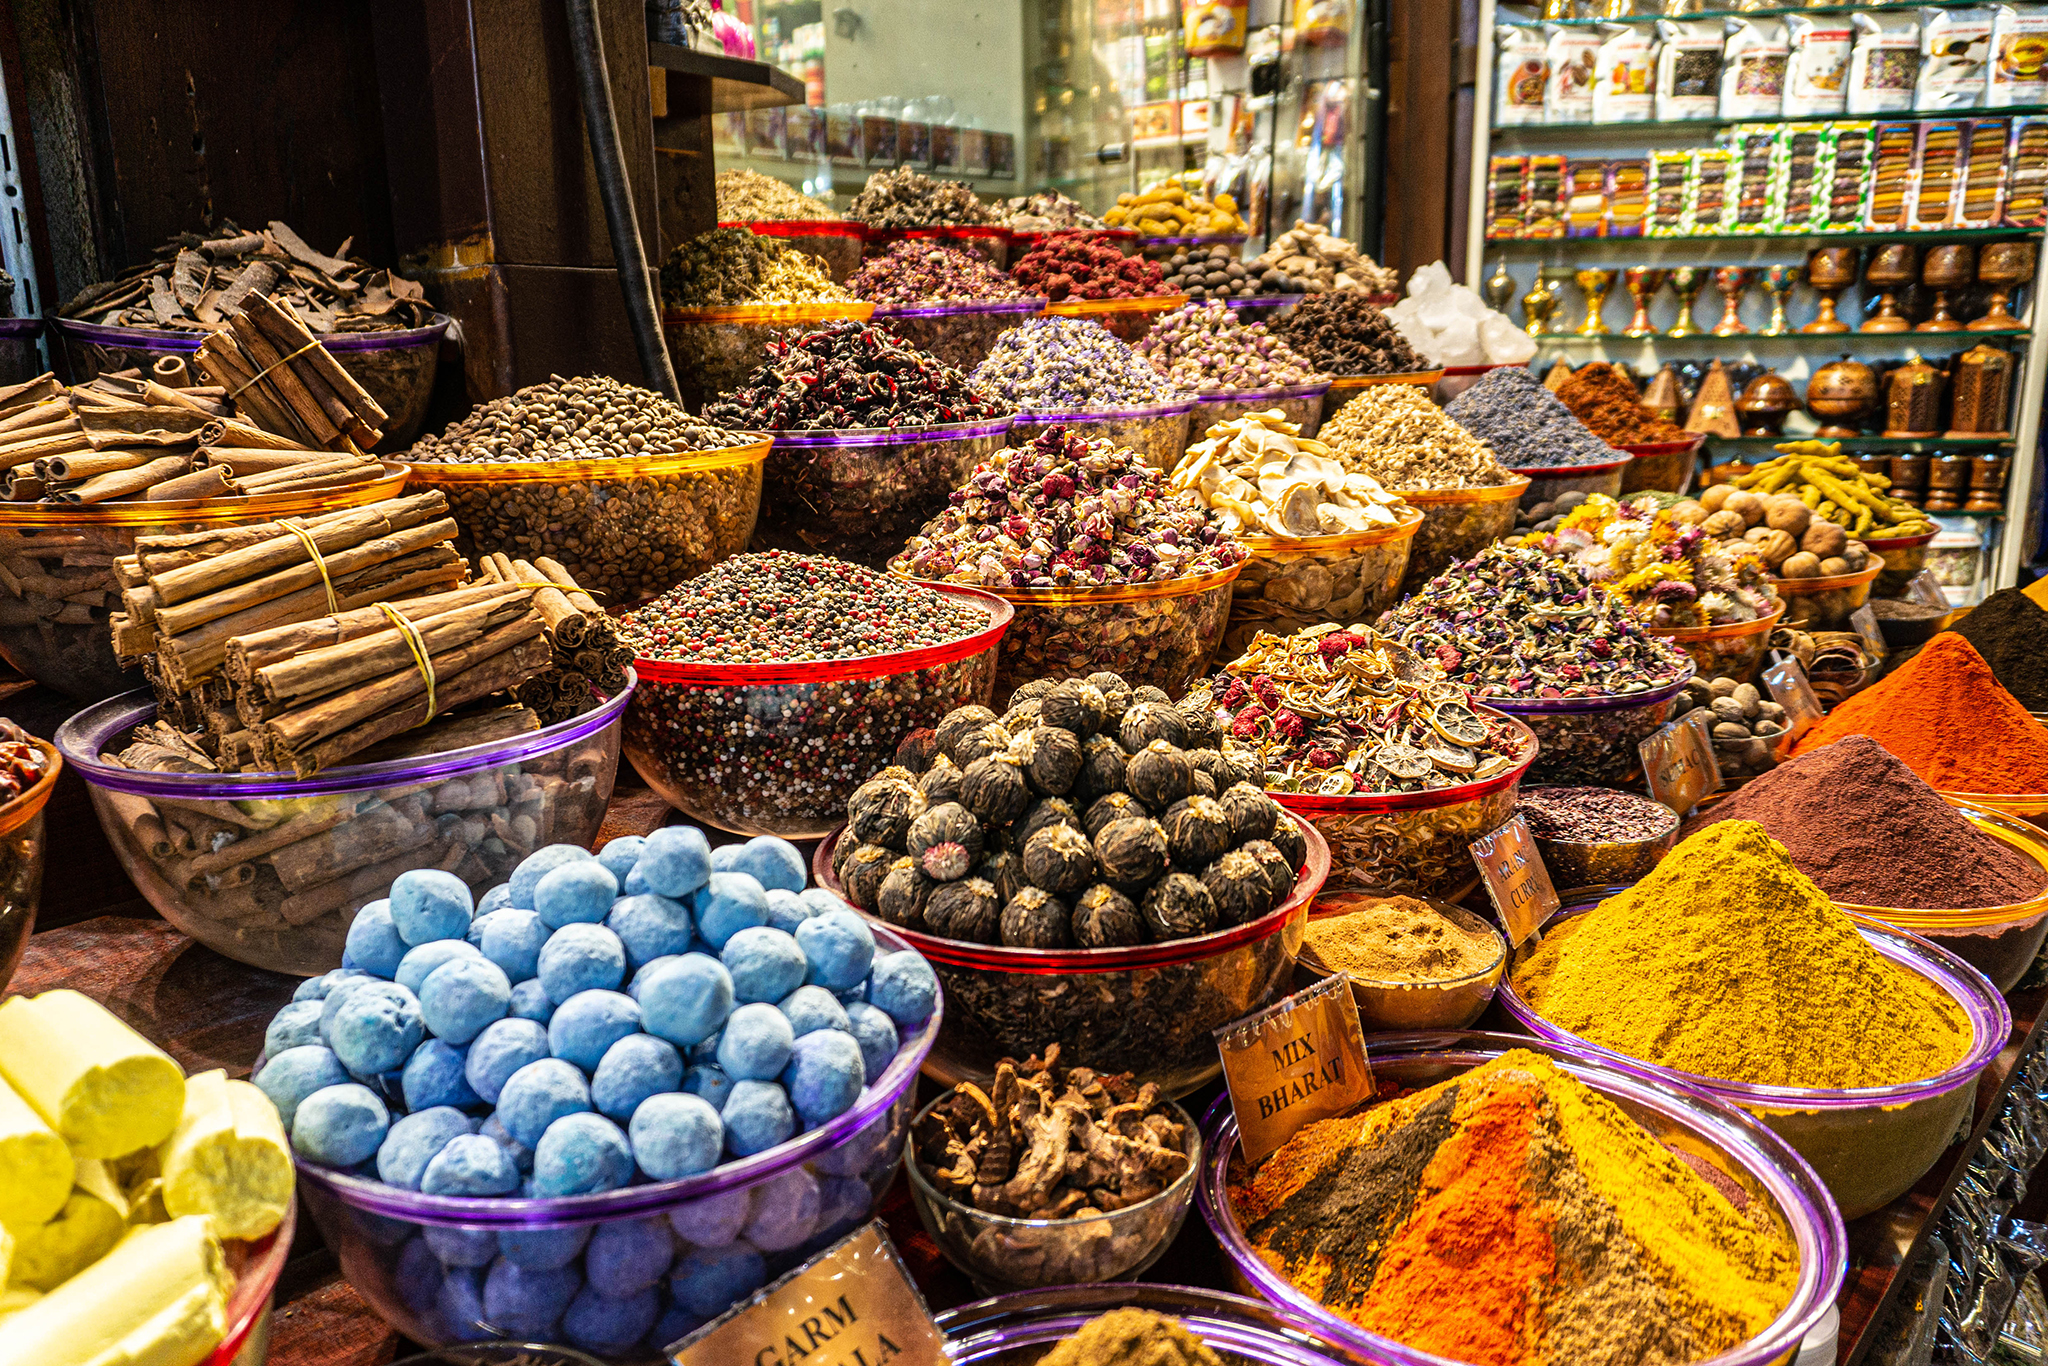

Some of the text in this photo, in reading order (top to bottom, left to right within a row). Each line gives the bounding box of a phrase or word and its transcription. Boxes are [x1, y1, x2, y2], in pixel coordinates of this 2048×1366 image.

[1497, 845, 1531, 883] ARABIC
[1510, 873, 1540, 909] CURRY
[1271, 1032, 1316, 1073] MIX
[1256, 1056, 1343, 1120] BHARAT
[754, 1293, 859, 1366] GARM
